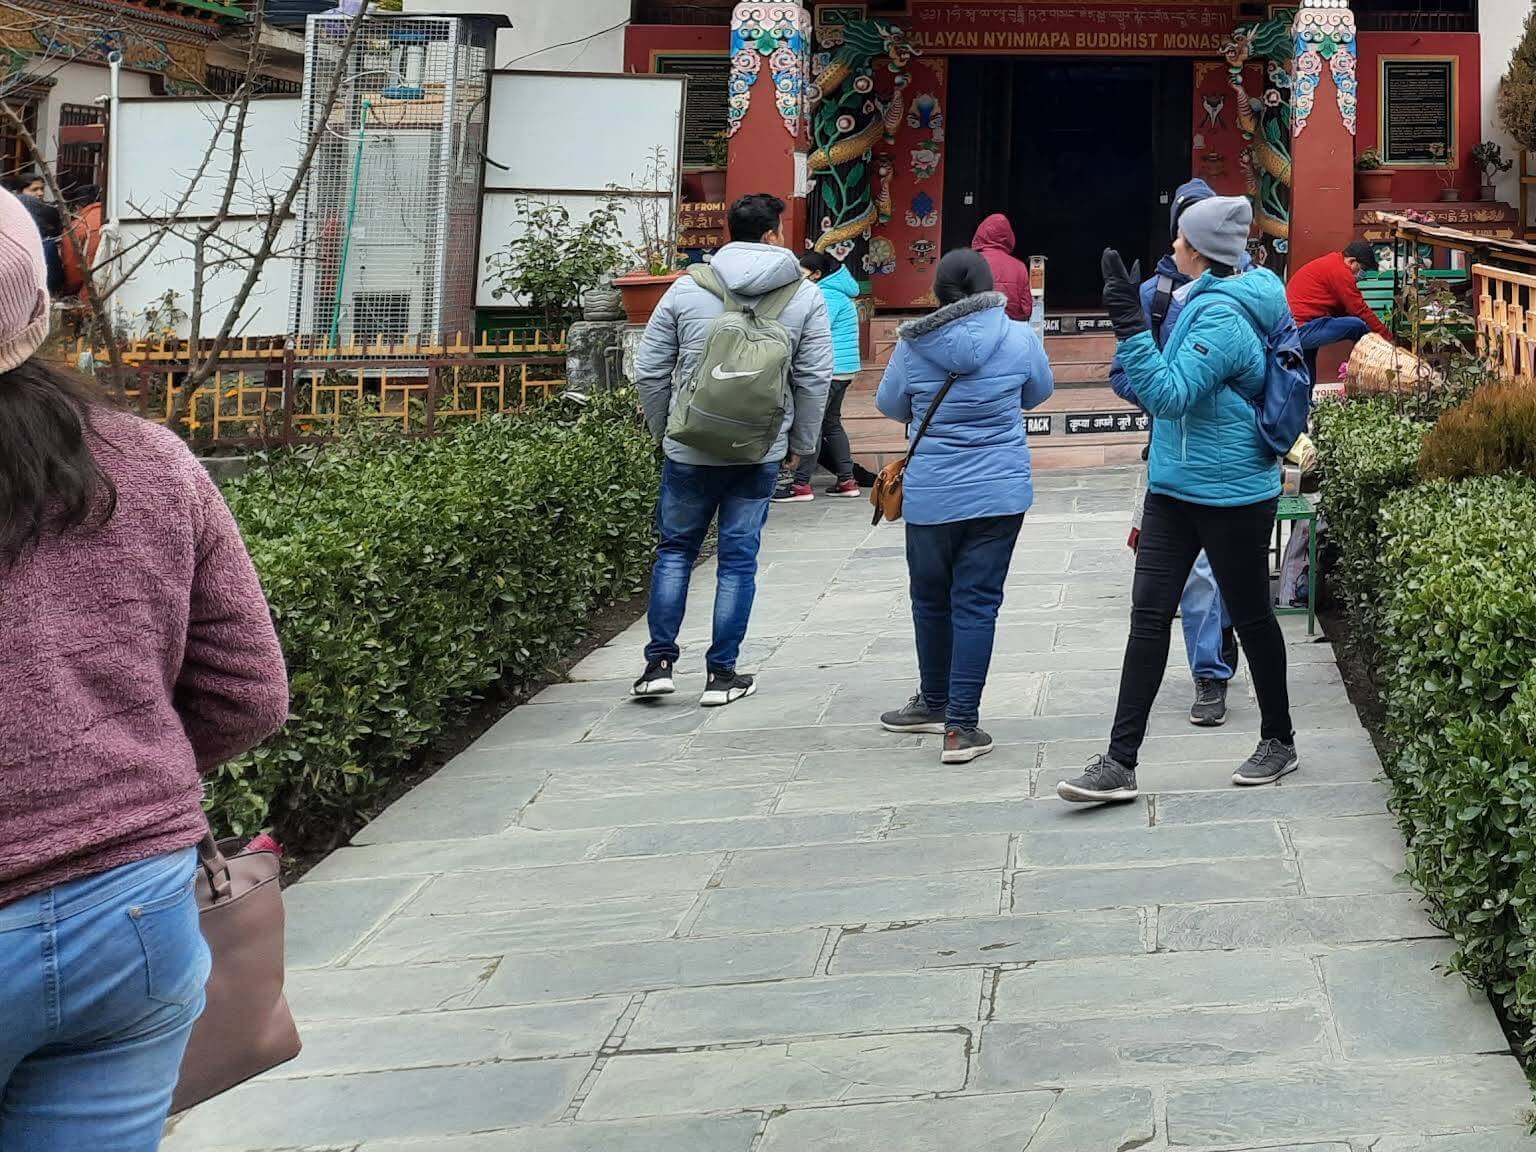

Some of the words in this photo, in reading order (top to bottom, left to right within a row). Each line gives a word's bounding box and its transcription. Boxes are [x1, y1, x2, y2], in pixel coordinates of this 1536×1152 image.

[911, 32, 978, 47] ALAYAN
[984, 32, 1070, 48] NYINMAPA
[1075, 32, 1158, 48] BUDDHIST
[1163, 32, 1222, 48] MONAS
[694, 202, 720, 212] FROM
[1028, 418, 1049, 432] RACK
